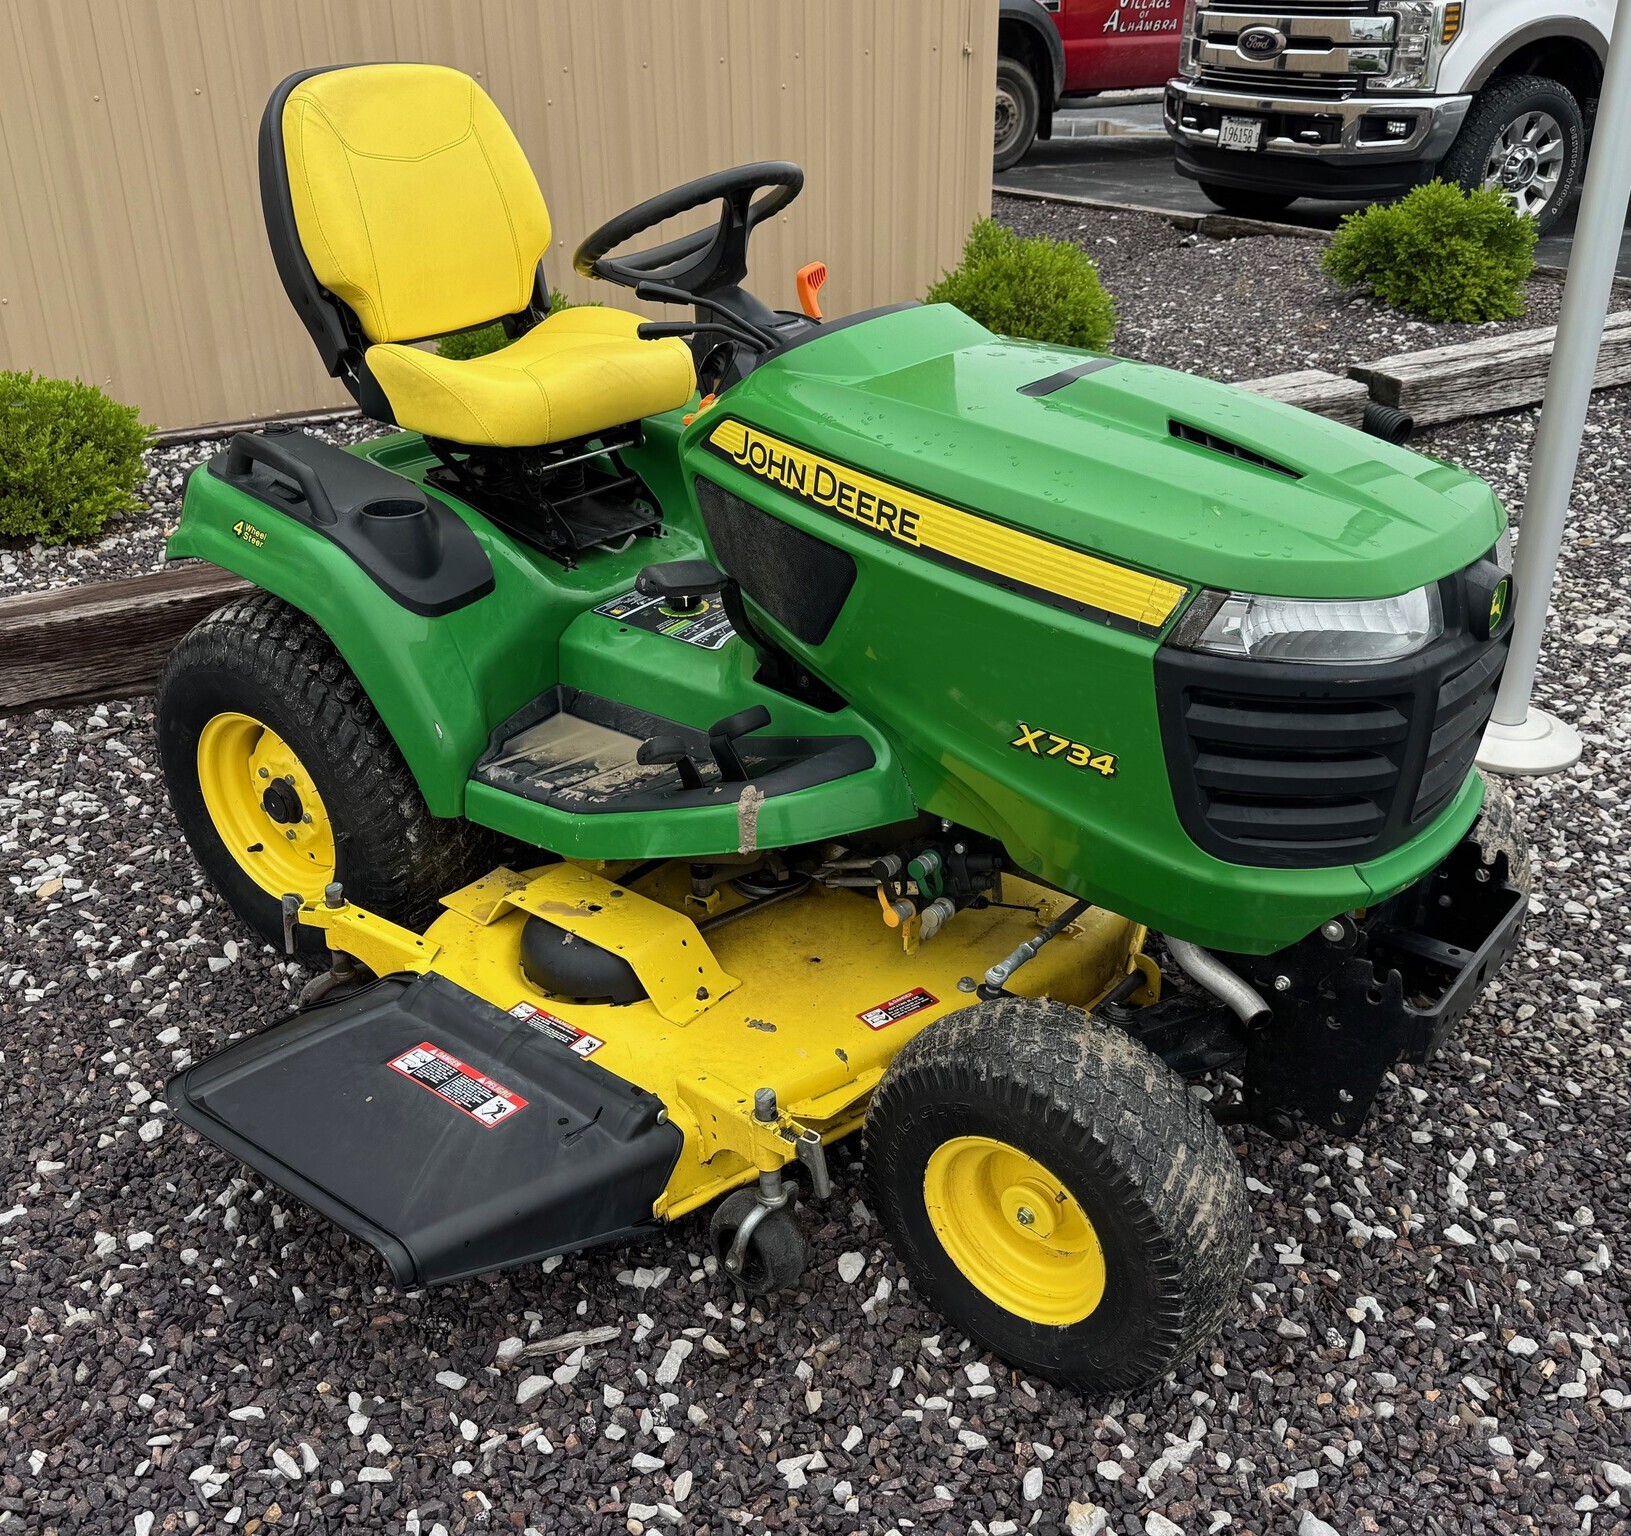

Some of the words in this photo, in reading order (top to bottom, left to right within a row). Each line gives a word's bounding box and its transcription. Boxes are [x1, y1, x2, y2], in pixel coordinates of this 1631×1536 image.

[1103, 9, 1177, 32] ALHAMBRA
[1245, 34, 1270, 49] Ford
[1222, 126, 1254, 144] 196158
[733, 430, 808, 495] JOHN
[813, 463, 921, 546] DEERE
[232, 520, 245, 537] 4
[245, 523, 268, 540] Wheel
[243, 531, 264, 548] Steer
[1011, 723, 1116, 776] X734
